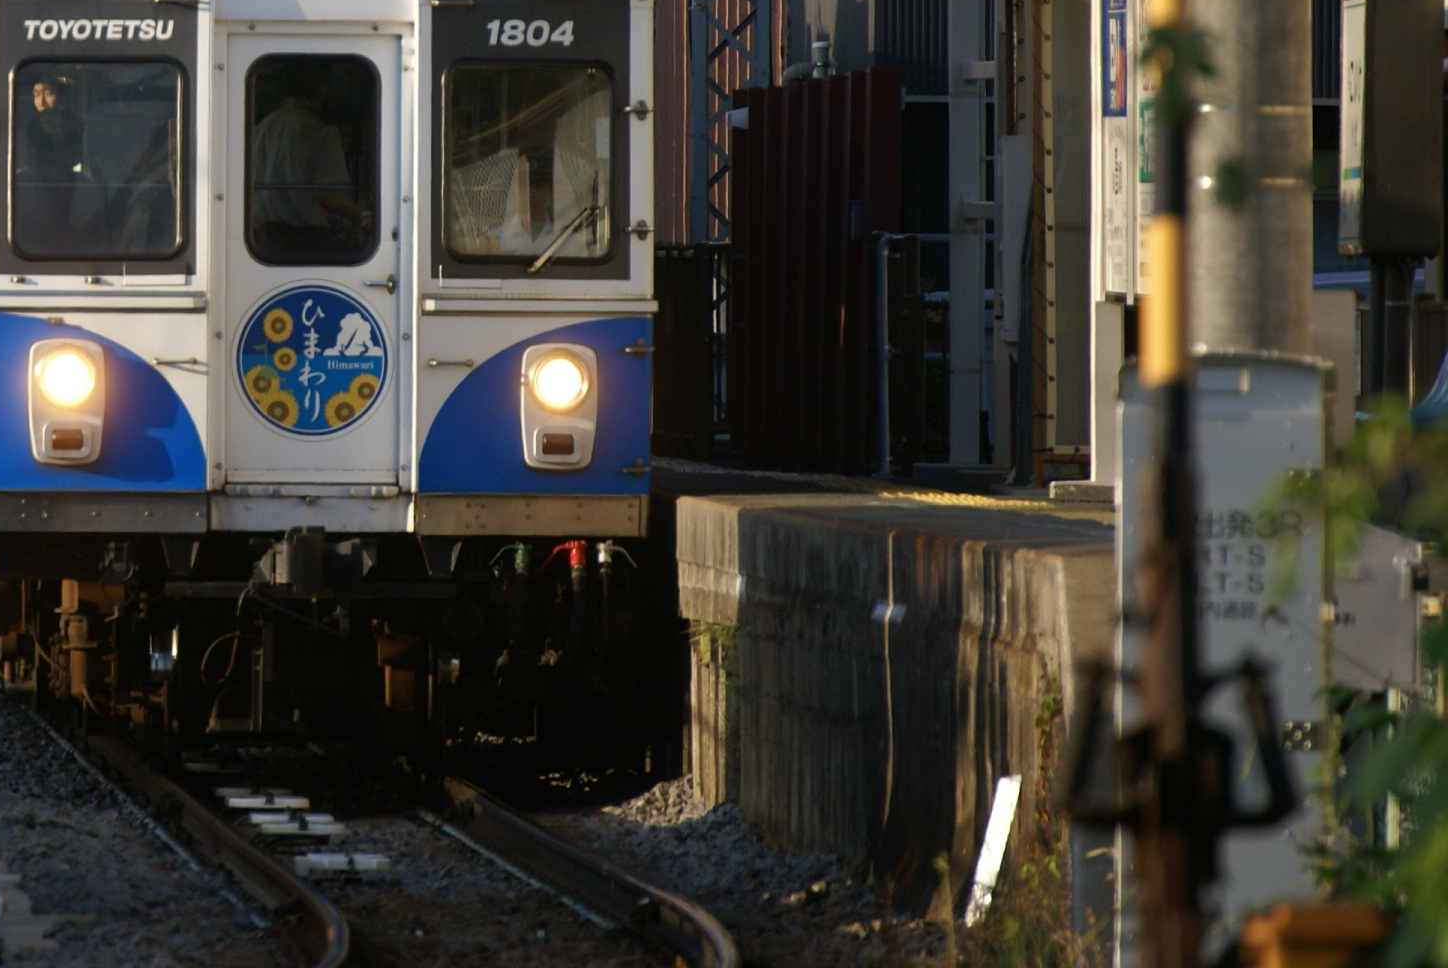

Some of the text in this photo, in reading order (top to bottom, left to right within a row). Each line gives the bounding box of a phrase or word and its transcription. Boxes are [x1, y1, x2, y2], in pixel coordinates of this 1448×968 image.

[24, 18, 175, 42] TOYOTETSU
[485, 19, 576, 47] 1804
[298, 298, 327, 423] ひまわり
[327, 359, 374, 369] Himawari
